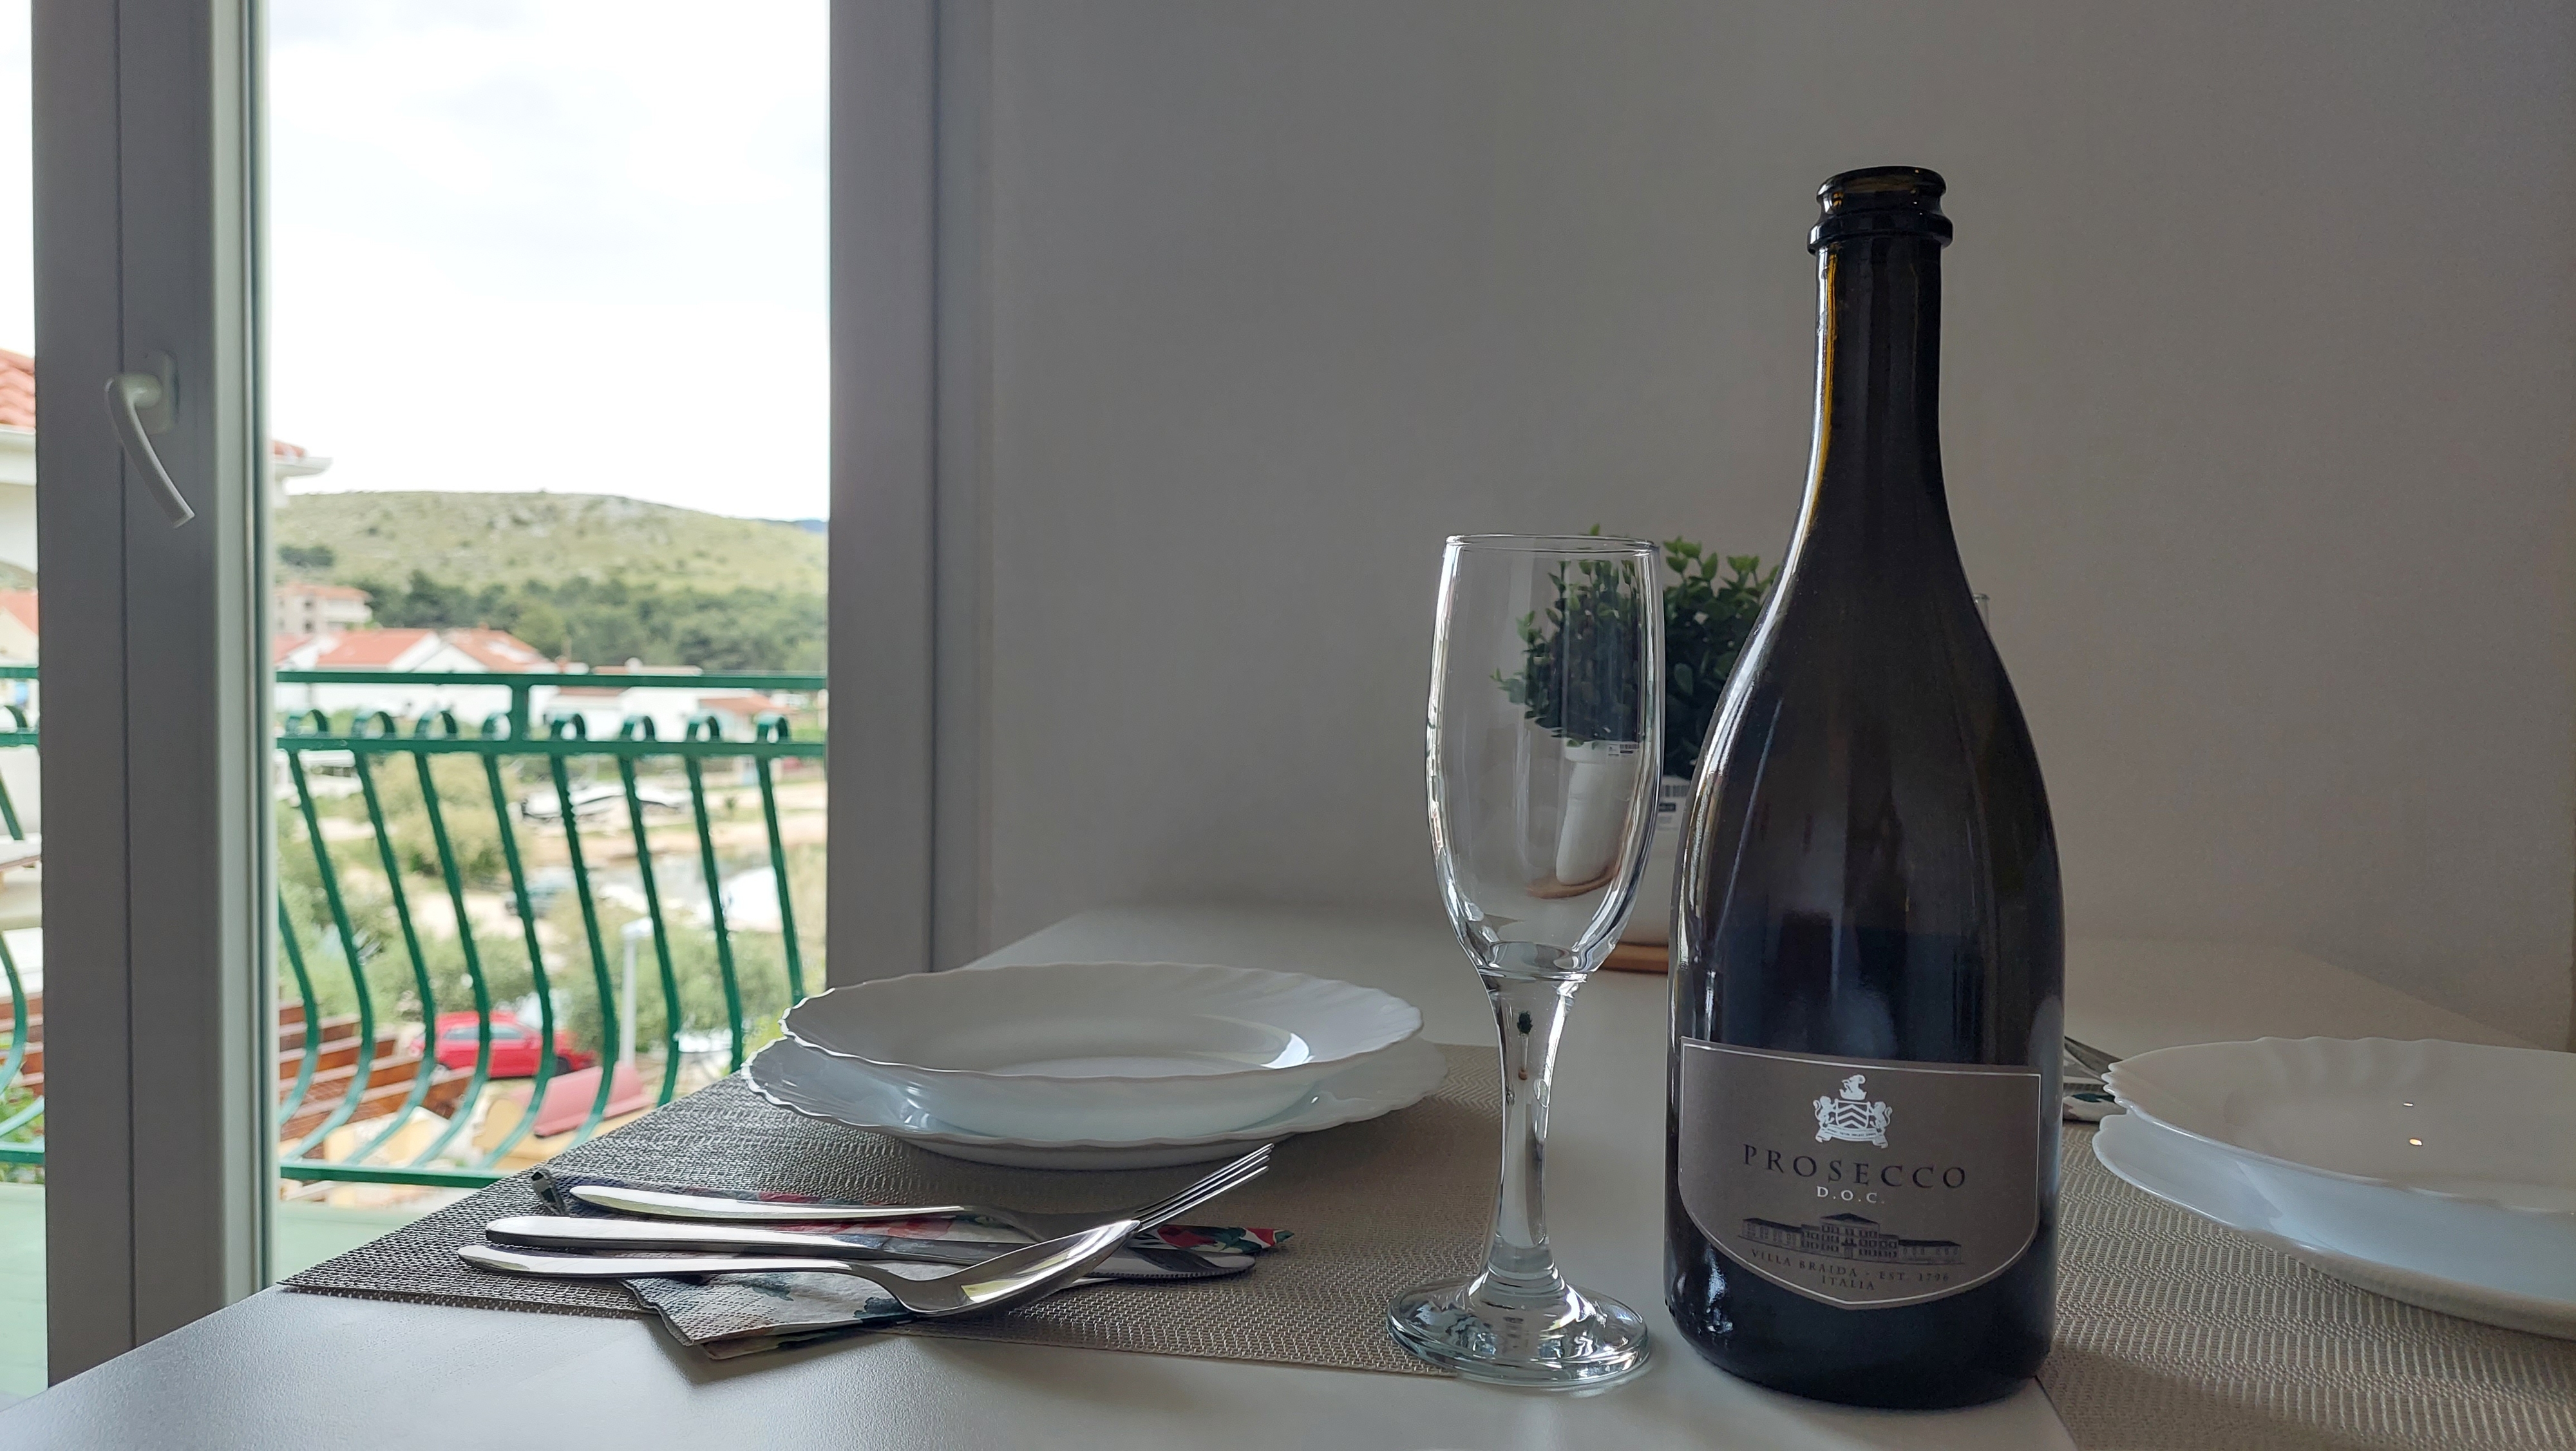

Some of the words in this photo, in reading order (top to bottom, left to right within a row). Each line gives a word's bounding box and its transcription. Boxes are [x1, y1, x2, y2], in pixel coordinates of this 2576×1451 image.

[1743, 1144, 1965, 1189] PROSECCO
[1751, 1249, 1791, 1266] VILLA
[1799, 1260, 1857, 1278] BRAIDA
[1879, 1271, 1905, 1281] EST
[1823, 1275, 1875, 1290] ITALIA
